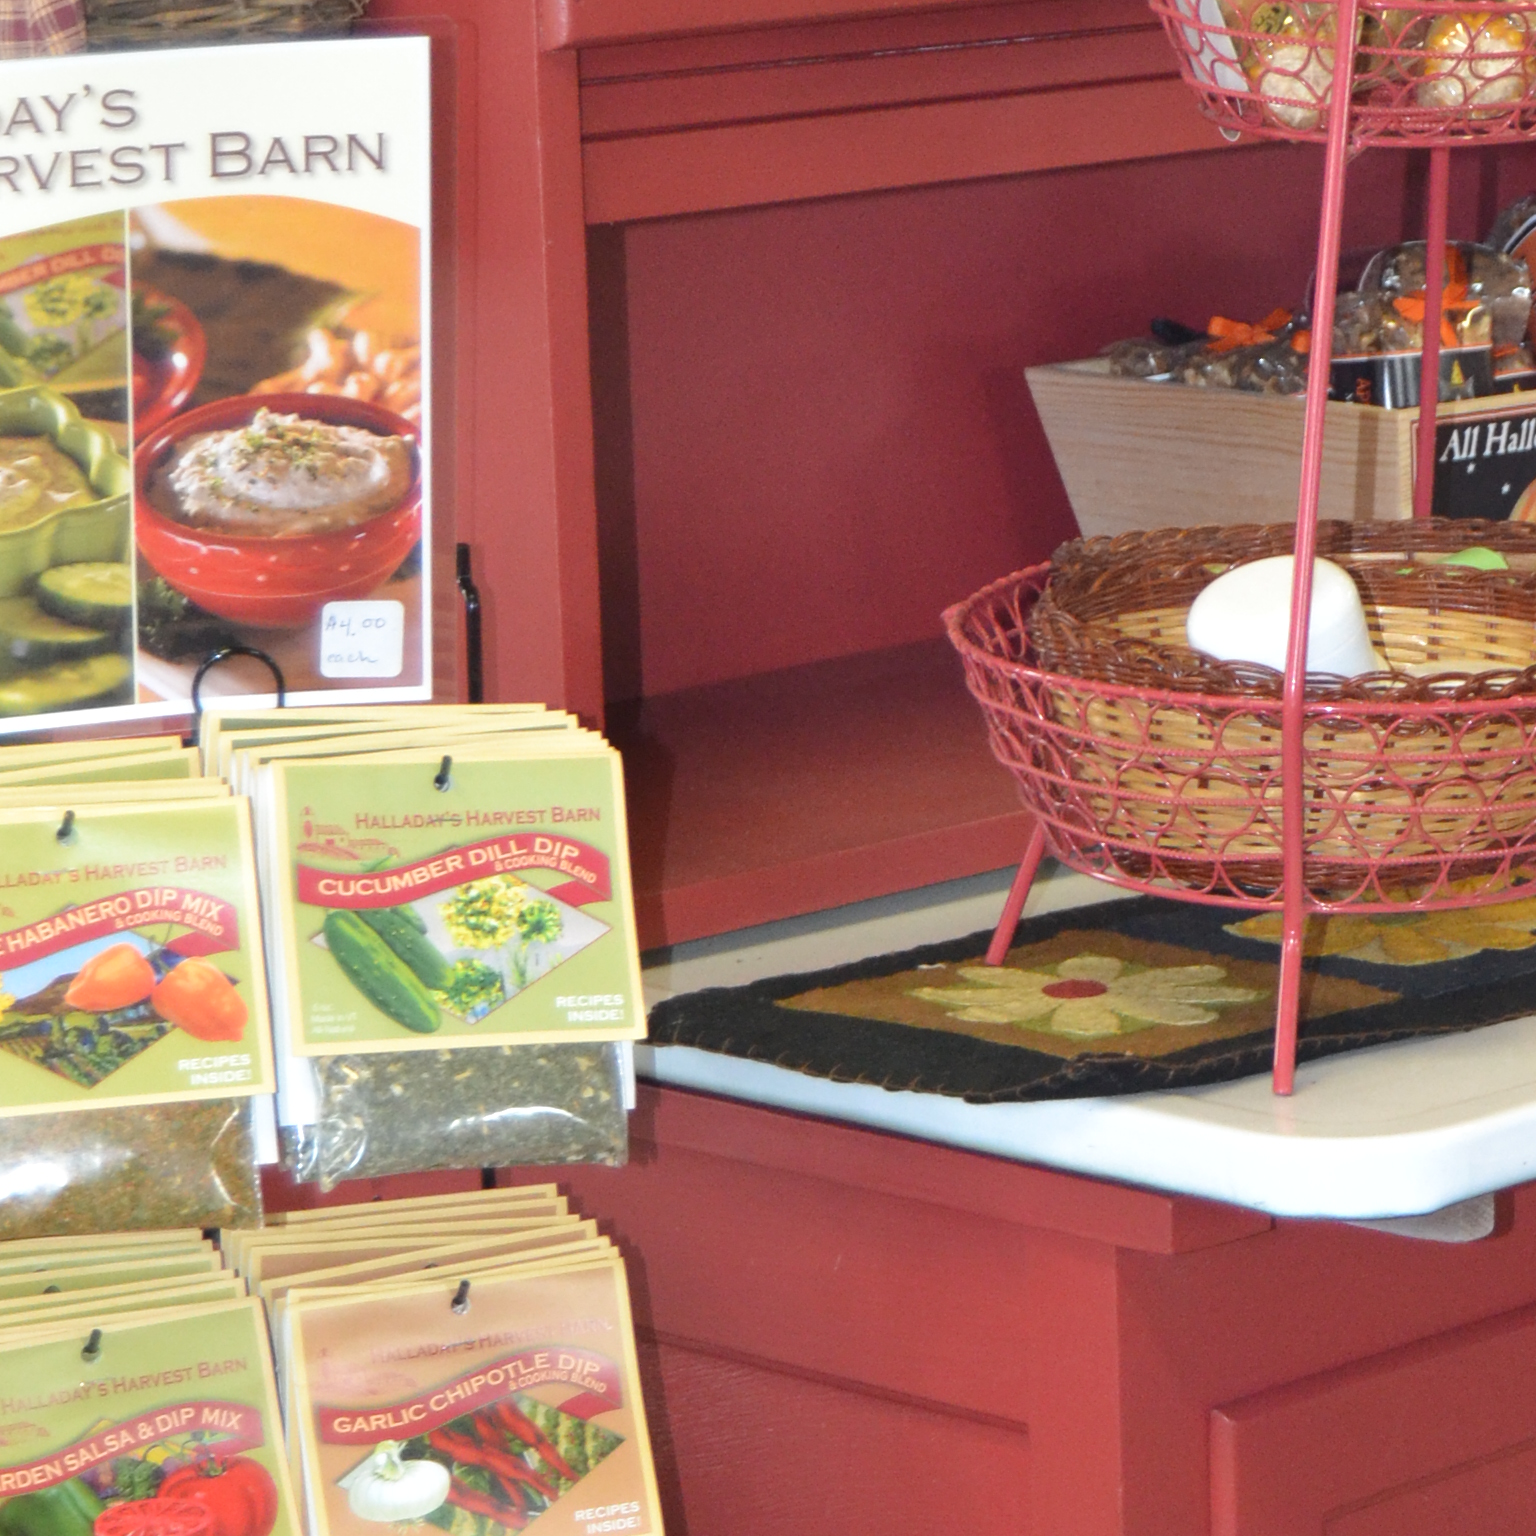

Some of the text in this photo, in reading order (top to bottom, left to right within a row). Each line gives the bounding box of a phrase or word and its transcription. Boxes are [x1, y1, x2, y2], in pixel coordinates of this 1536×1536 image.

[0, 84, 138, 137] AY'S
[0, 130, 386, 193] RVEST BARN
[1439, 425, 1481, 463] All
[355, 806, 601, 831] HALLADAY'S HARVEST BARN
[85, 859, 170, 881] HARVEST
[174, 854, 228, 872] BARN
[317, 836, 581, 898] CUCUMBER DILL DIP
[504, 855, 558, 872] COOKING
[559, 858, 597, 885] BLEND
[5, 887, 225, 954] HABANERO DIP MIX
[125, 910, 182, 927] COOKING
[184, 912, 225, 937] BLEND
[555, 993, 624, 1009] RECIPES
[567, 1009, 624, 1023] INSIDE!
[178, 1054, 251, 1072] RECIPES
[478, 1326, 558, 1350] HARVEST
[1, 1357, 248, 1415] HALLADAY'S HARVEST BARN
[332, 1353, 601, 1434] GARLIC CHIPOTLE DIP
[518, 1370, 569, 1388] COOKING
[570, 1370, 608, 1394] BLEND
[63, 1428, 135, 1473] SALSA
[138, 1421, 155, 1441] &
[155, 1407, 197, 1434] DIP
[200, 1406, 244, 1432] MIX
[574, 1501, 641, 1522] RECIPES
